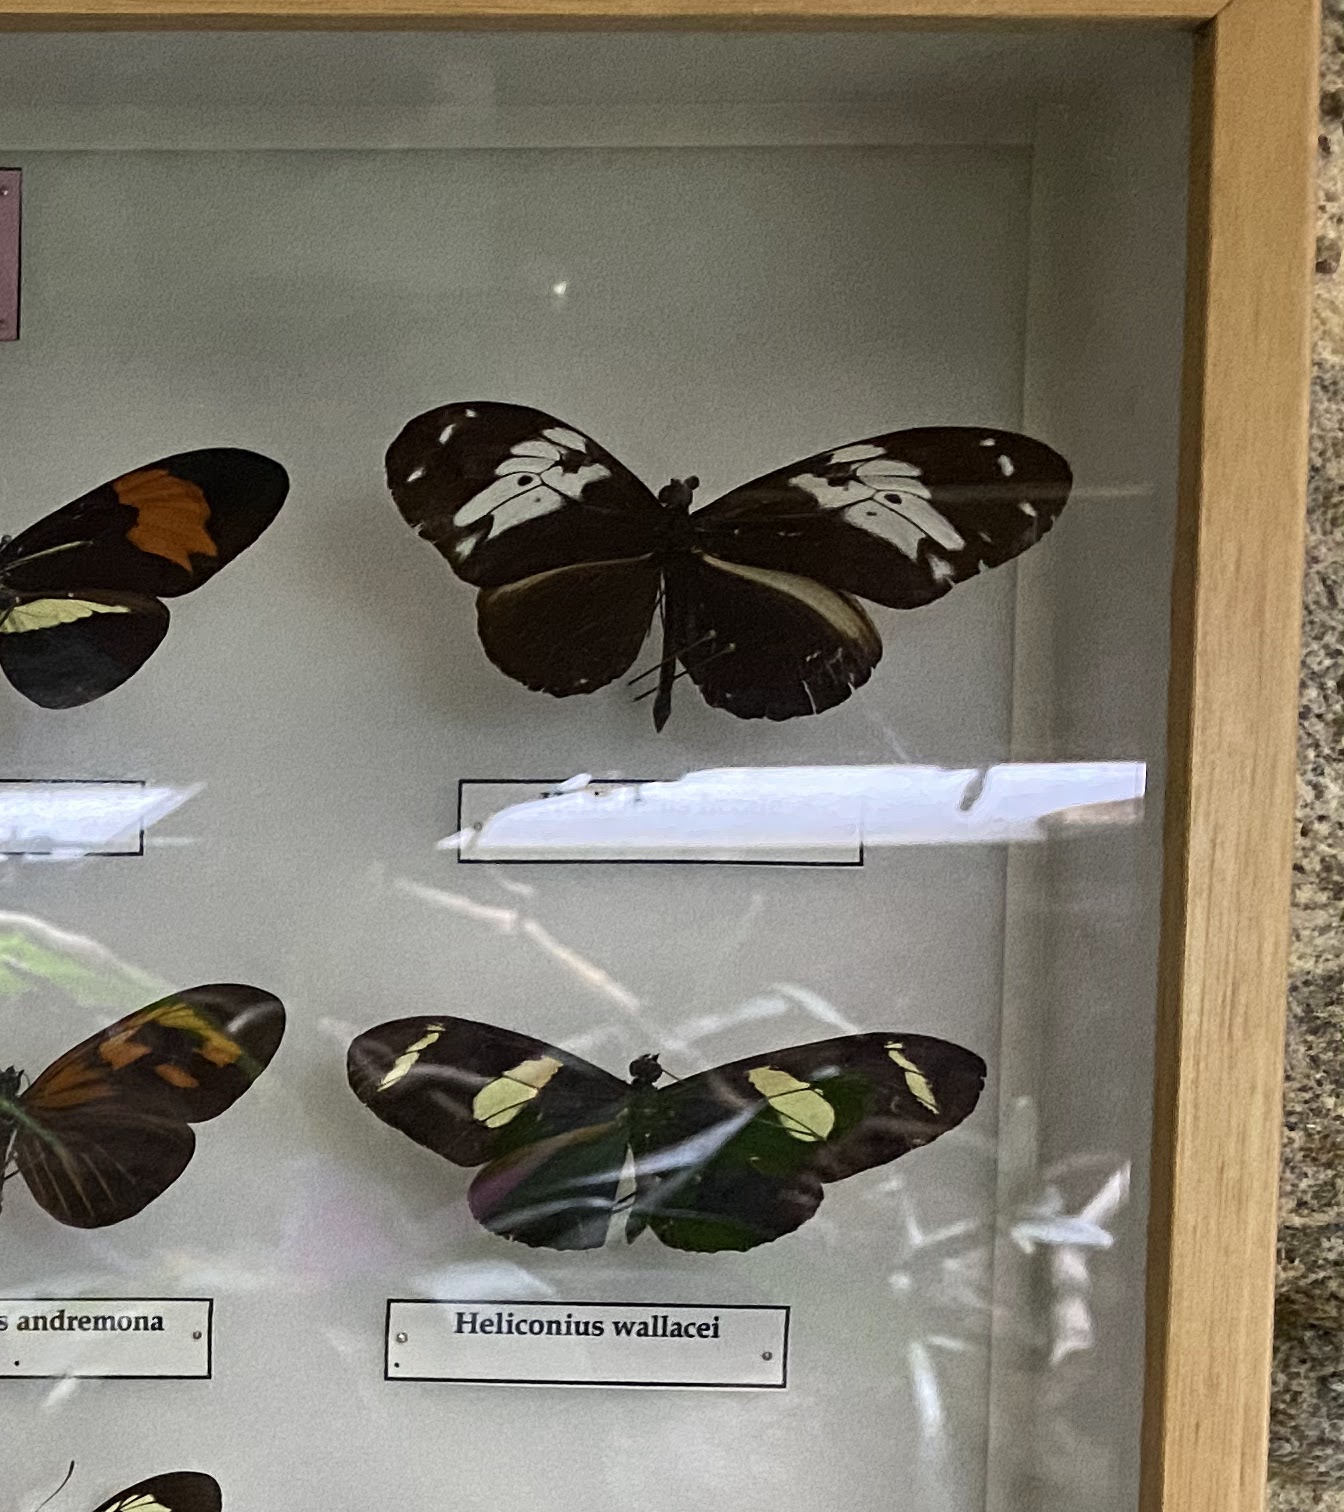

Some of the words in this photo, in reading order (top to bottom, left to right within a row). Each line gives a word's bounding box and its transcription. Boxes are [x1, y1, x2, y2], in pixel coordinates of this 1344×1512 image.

[15, 1309, 166, 1332] andremona
[453, 1311, 605, 1336] Heliconius
[611, 1314, 721, 1339] wallacei
